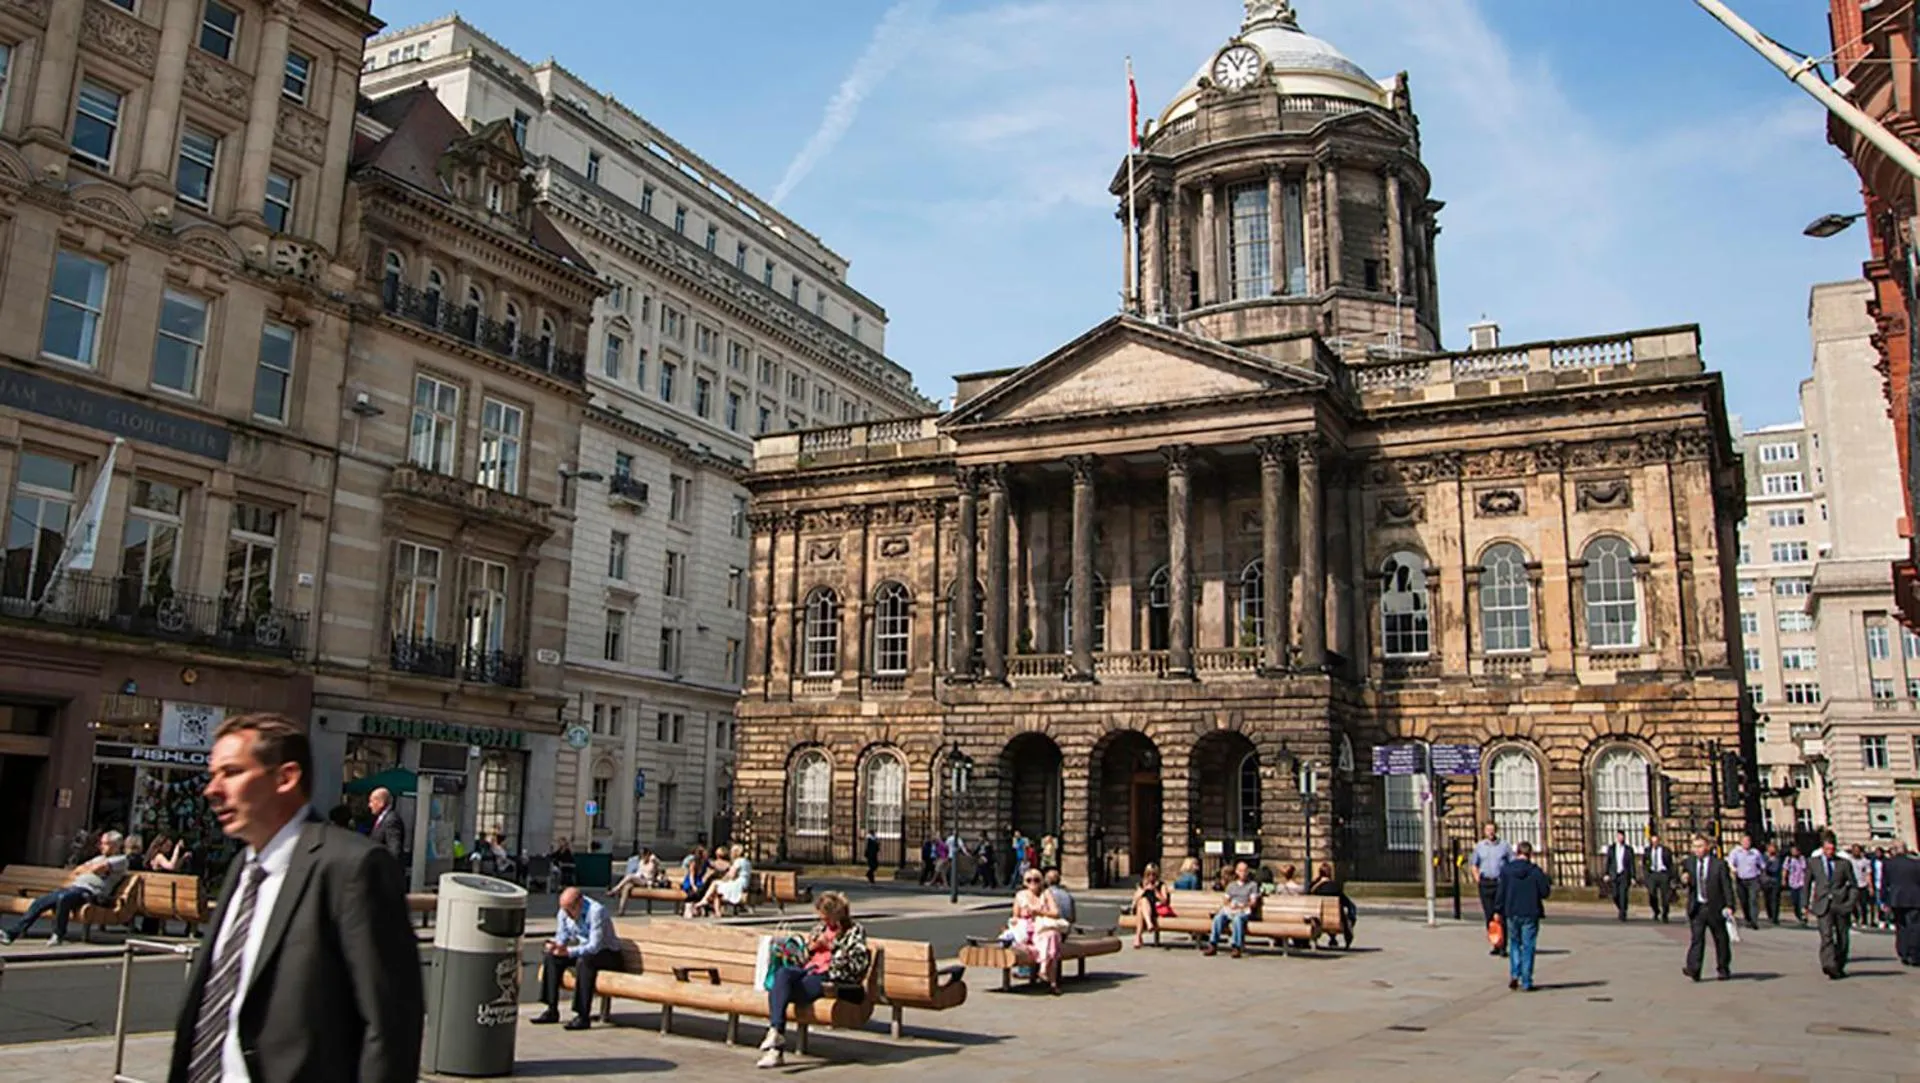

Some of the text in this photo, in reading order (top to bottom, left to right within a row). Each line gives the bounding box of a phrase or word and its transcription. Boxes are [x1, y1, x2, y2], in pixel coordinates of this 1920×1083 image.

[54, 393, 93, 417] AND
[107, 409, 216, 450] GLOUCESTER
[363, 714, 523, 747] STARBUCKS COFFEE
[132, 747, 210, 764] FISHLO
